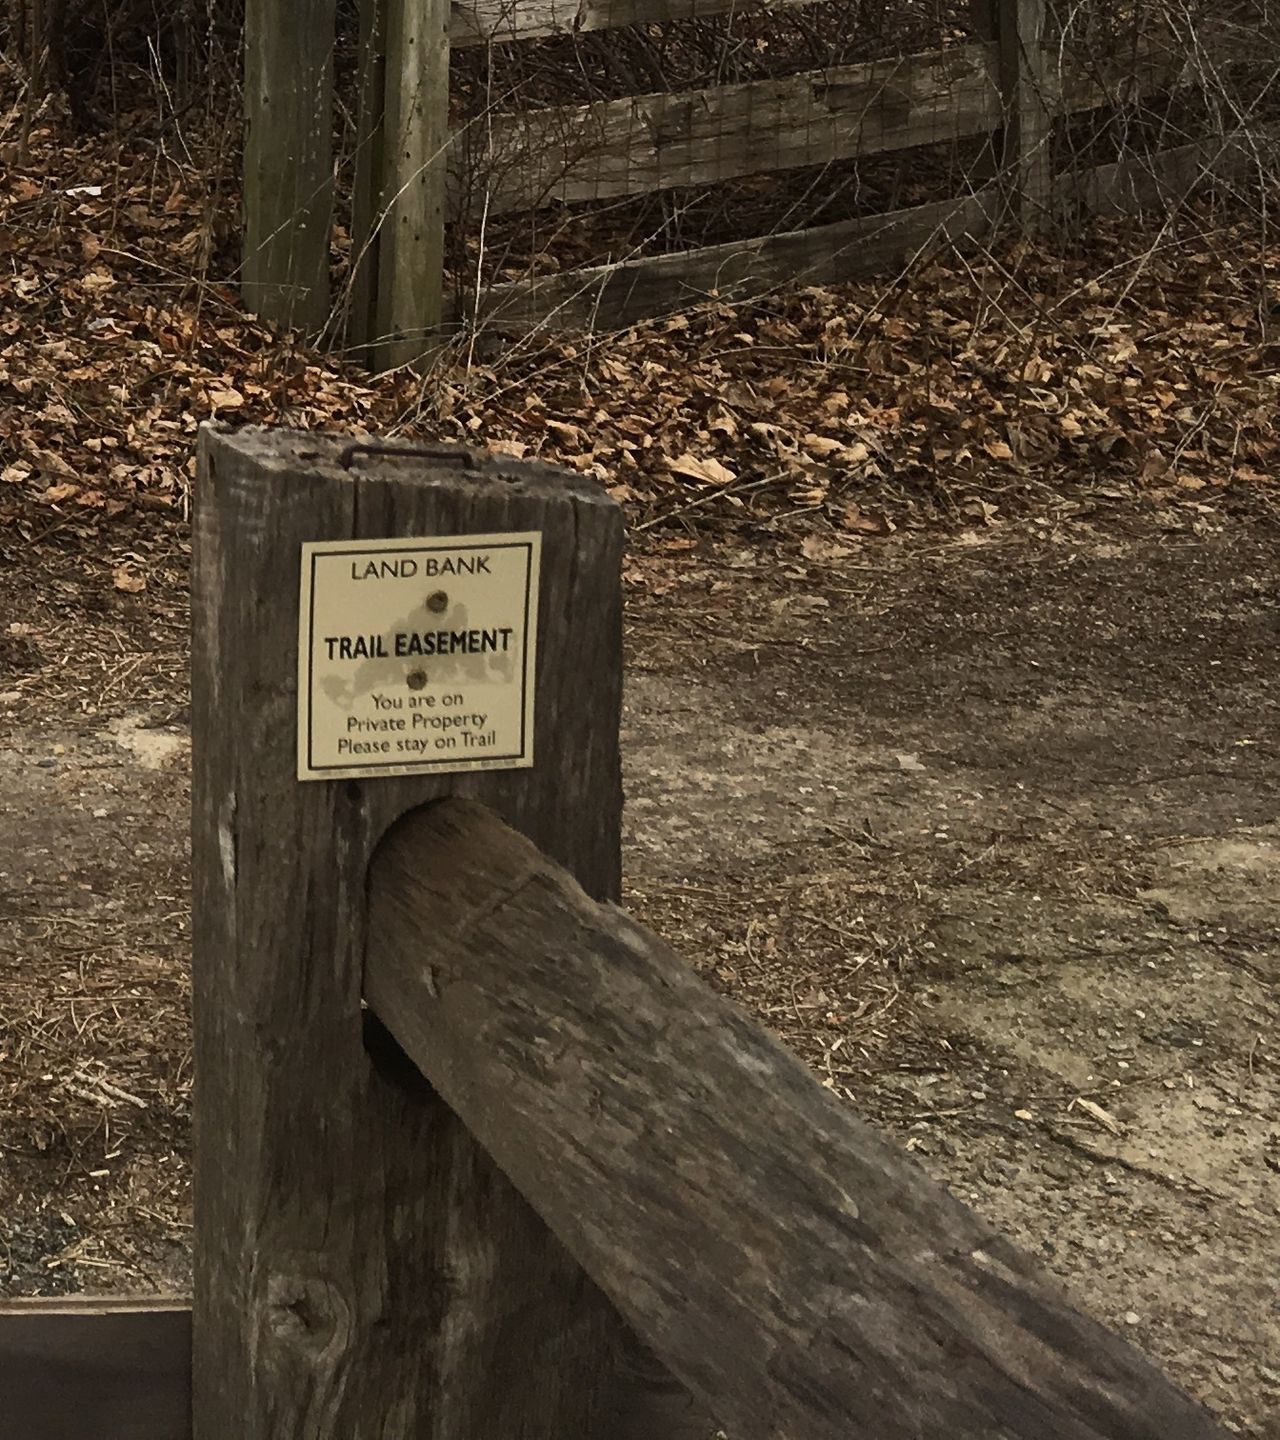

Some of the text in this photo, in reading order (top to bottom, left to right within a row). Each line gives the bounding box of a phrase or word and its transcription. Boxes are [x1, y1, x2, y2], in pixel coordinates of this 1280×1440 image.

[351, 556, 491, 580] LAND BANK
[325, 628, 513, 660] TRAIL EASEMENT
[372, 694, 463, 710] You are on
[347, 713, 488, 732] Private Property
[338, 731, 495, 754] Please stay on Trail
